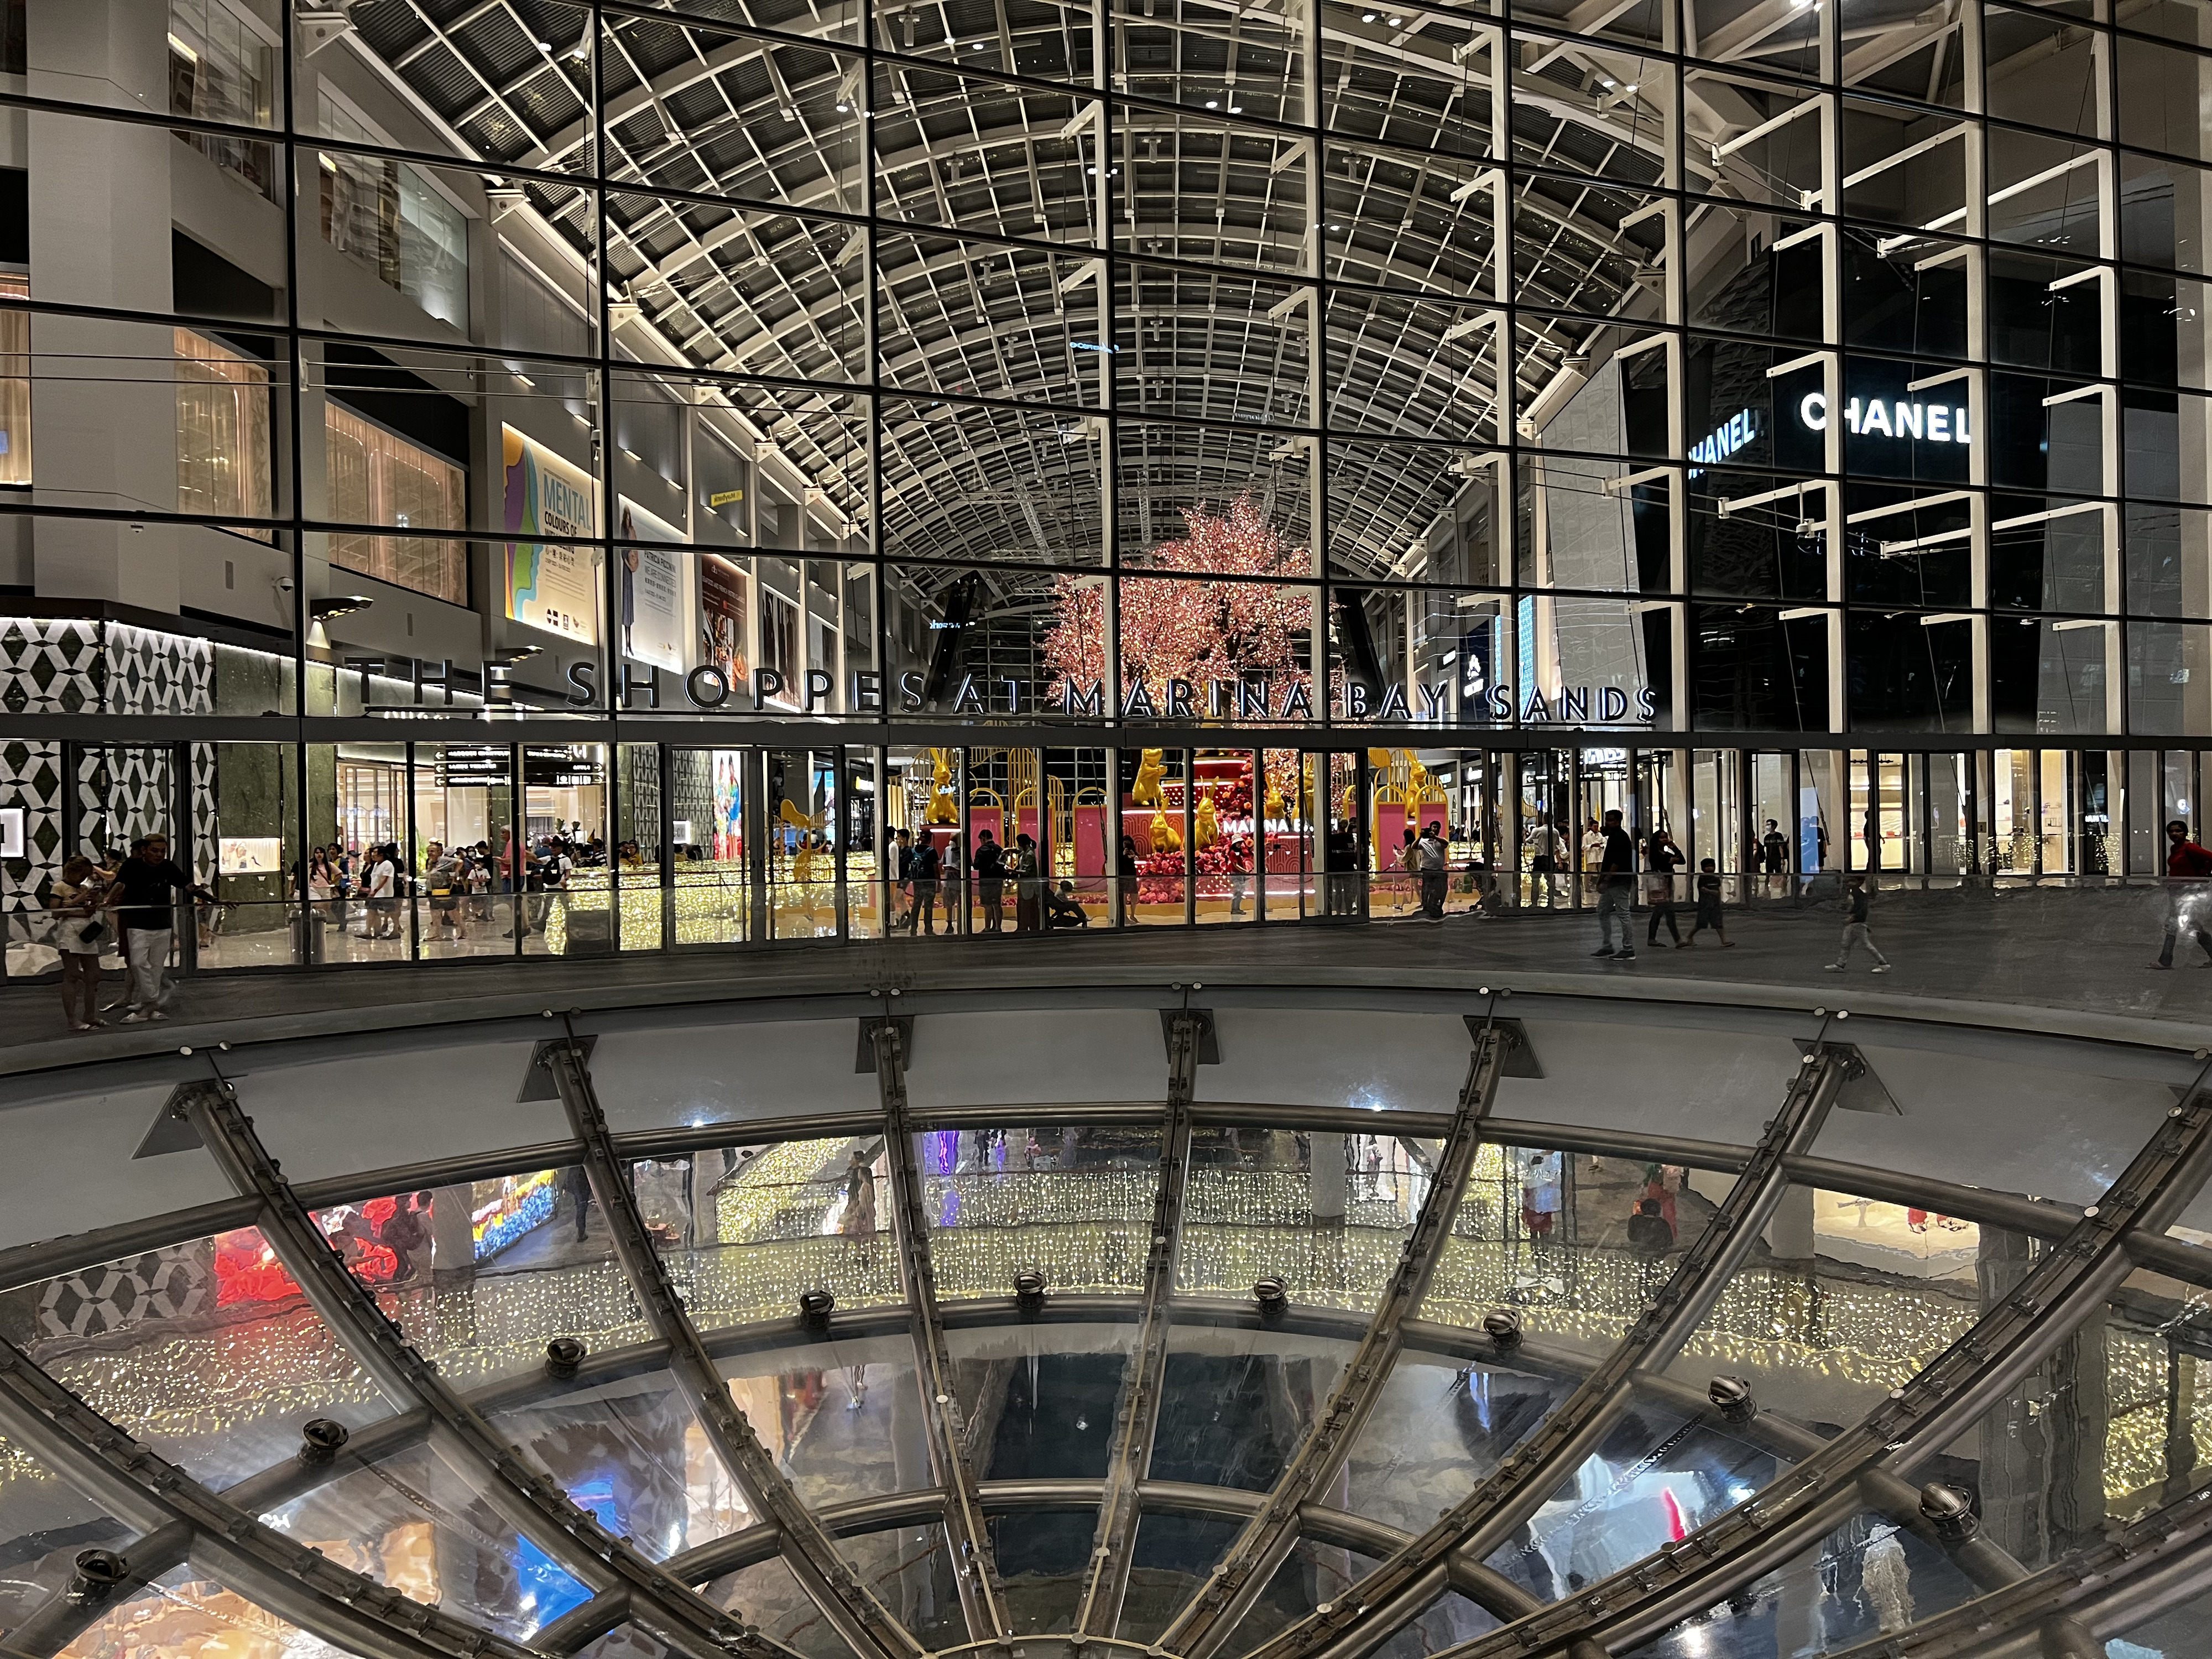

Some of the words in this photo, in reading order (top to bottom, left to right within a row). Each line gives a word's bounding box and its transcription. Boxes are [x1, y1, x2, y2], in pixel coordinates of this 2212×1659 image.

[1688, 408, 1755, 480] HANEL
[1801, 392, 1971, 444] CHANEL
[544, 474, 591, 531] MENTAL
[545, 511, 569, 535] COLOURS
[345, 658, 512, 706] THE
[566, 662, 925, 713] SHOPPES
[952, 673, 1031, 714] AT
[1062, 676, 1314, 718] MARINA
[1345, 679, 1448, 719] BAY
[1489, 684, 1657, 722] SANDS
